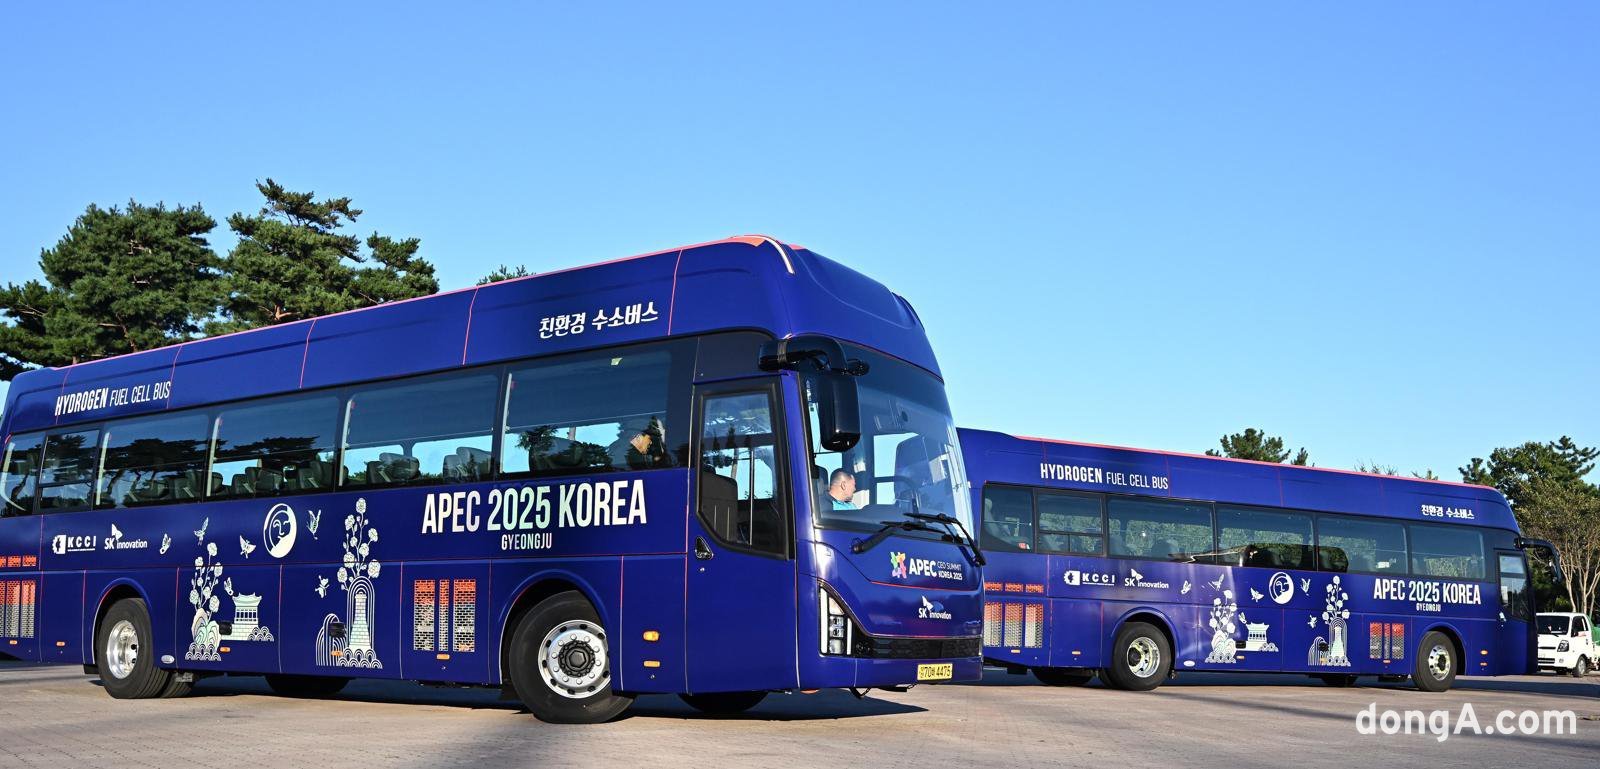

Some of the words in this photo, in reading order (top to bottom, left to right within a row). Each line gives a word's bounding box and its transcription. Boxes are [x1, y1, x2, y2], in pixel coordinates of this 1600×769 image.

[539, 312, 585, 338] 친환경
[592, 302, 658, 330] 수소버스
[55, 388, 108, 416] HYDROGEN
[110, 388, 128, 406] FUEL
[131, 385, 150, 403] CELL
[153, 381, 171, 400] BUS
[1041, 463, 1102, 483] HYDROGEN
[1107, 472, 1127, 485] FUEL
[1130, 474, 1150, 487] CELL
[1152, 477, 1168, 489] BUS
[422, 491, 480, 533] APEC
[488, 486, 550, 530] 2025
[559, 480, 646, 527] KOREA
[1422, 505, 1443, 517] 친환경
[1446, 508, 1474, 519] 수소버스
[68, 536, 96, 547] KCCI
[105, 538, 115, 549] SK
[116, 538, 147, 549] innovation
[501, 533, 552, 550] GYEONGJU
[909, 558, 937, 577] APEC
[938, 571, 953, 579] KOREA
[1083, 573, 1115, 582] KCCI
[1125, 576, 1135, 586] SK
[1138, 580, 1169, 588] innovation
[1374, 579, 1405, 600] APEC
[1409, 581, 1439, 602] 2025
[1443, 583, 1481, 604] KOREA
[919, 608, 927, 618] SK
[929, 610, 951, 619] innovation
[1416, 603, 1441, 611] GYEONGJU
[936, 665, 951, 677] 4475
